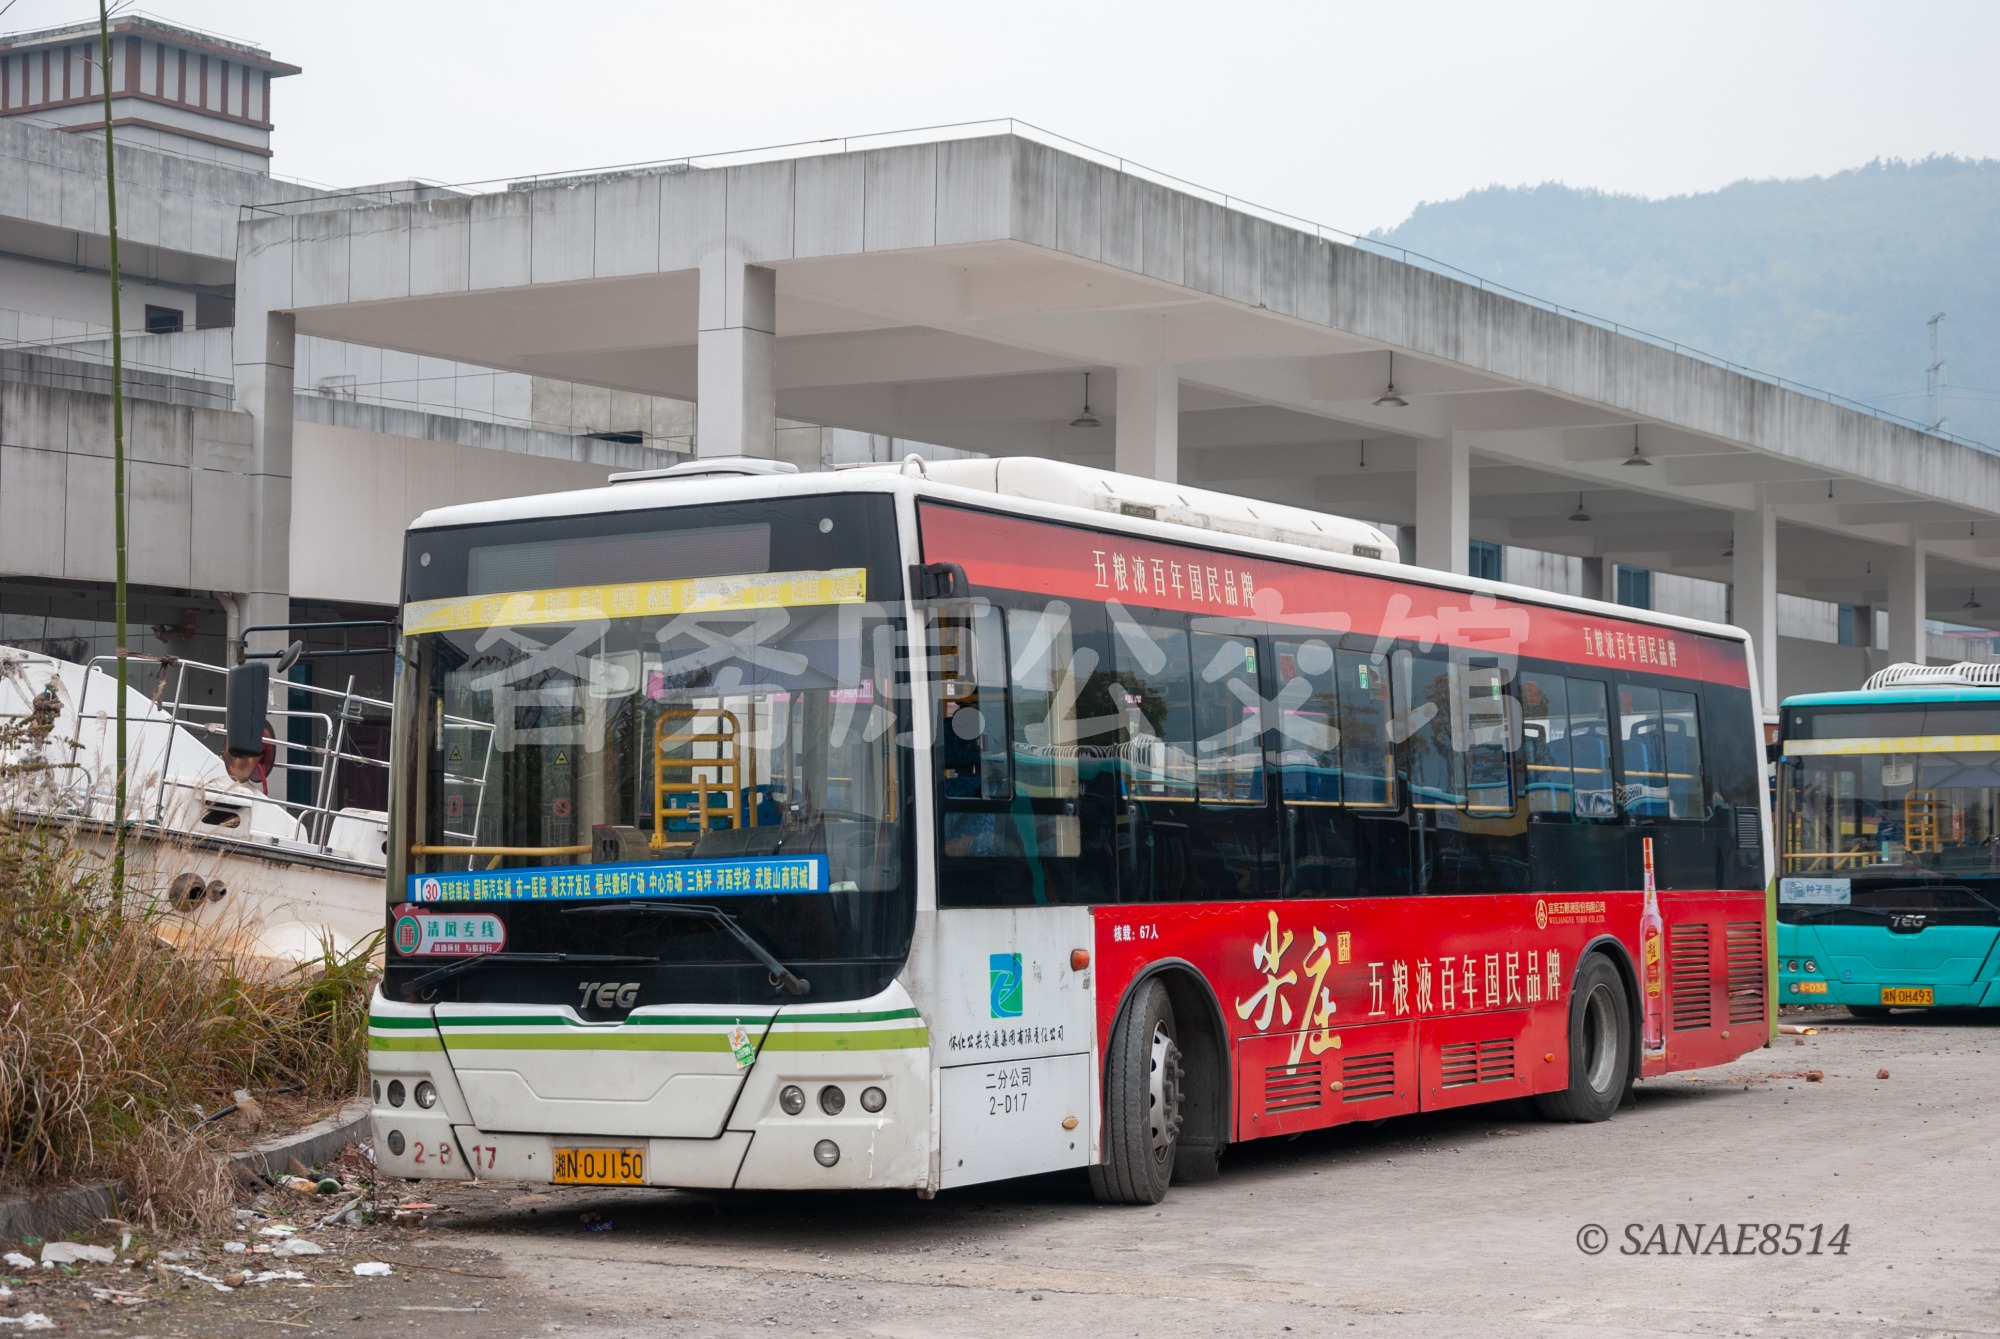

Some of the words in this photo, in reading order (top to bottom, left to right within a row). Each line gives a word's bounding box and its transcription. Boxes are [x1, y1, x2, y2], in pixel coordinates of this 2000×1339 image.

[1093, 550, 1255, 608] 五粮液百年国民品牌
[612, 587, 638, 614] 平等
[647, 585, 672, 610] 公正
[1583, 627, 1677, 668] 五粮液百年国民品牌
[425, 883, 438, 900] 30
[428, 921, 494, 937] 清风专线
[1891, 915, 1926, 927] TEG
[578, 982, 641, 1008] TEG
[1367, 949, 1561, 1017] 五粮液百年国民品牌
[985, 1067, 1031, 1090] 二分公司
[989, 1093, 1027, 1115] 2-D17
